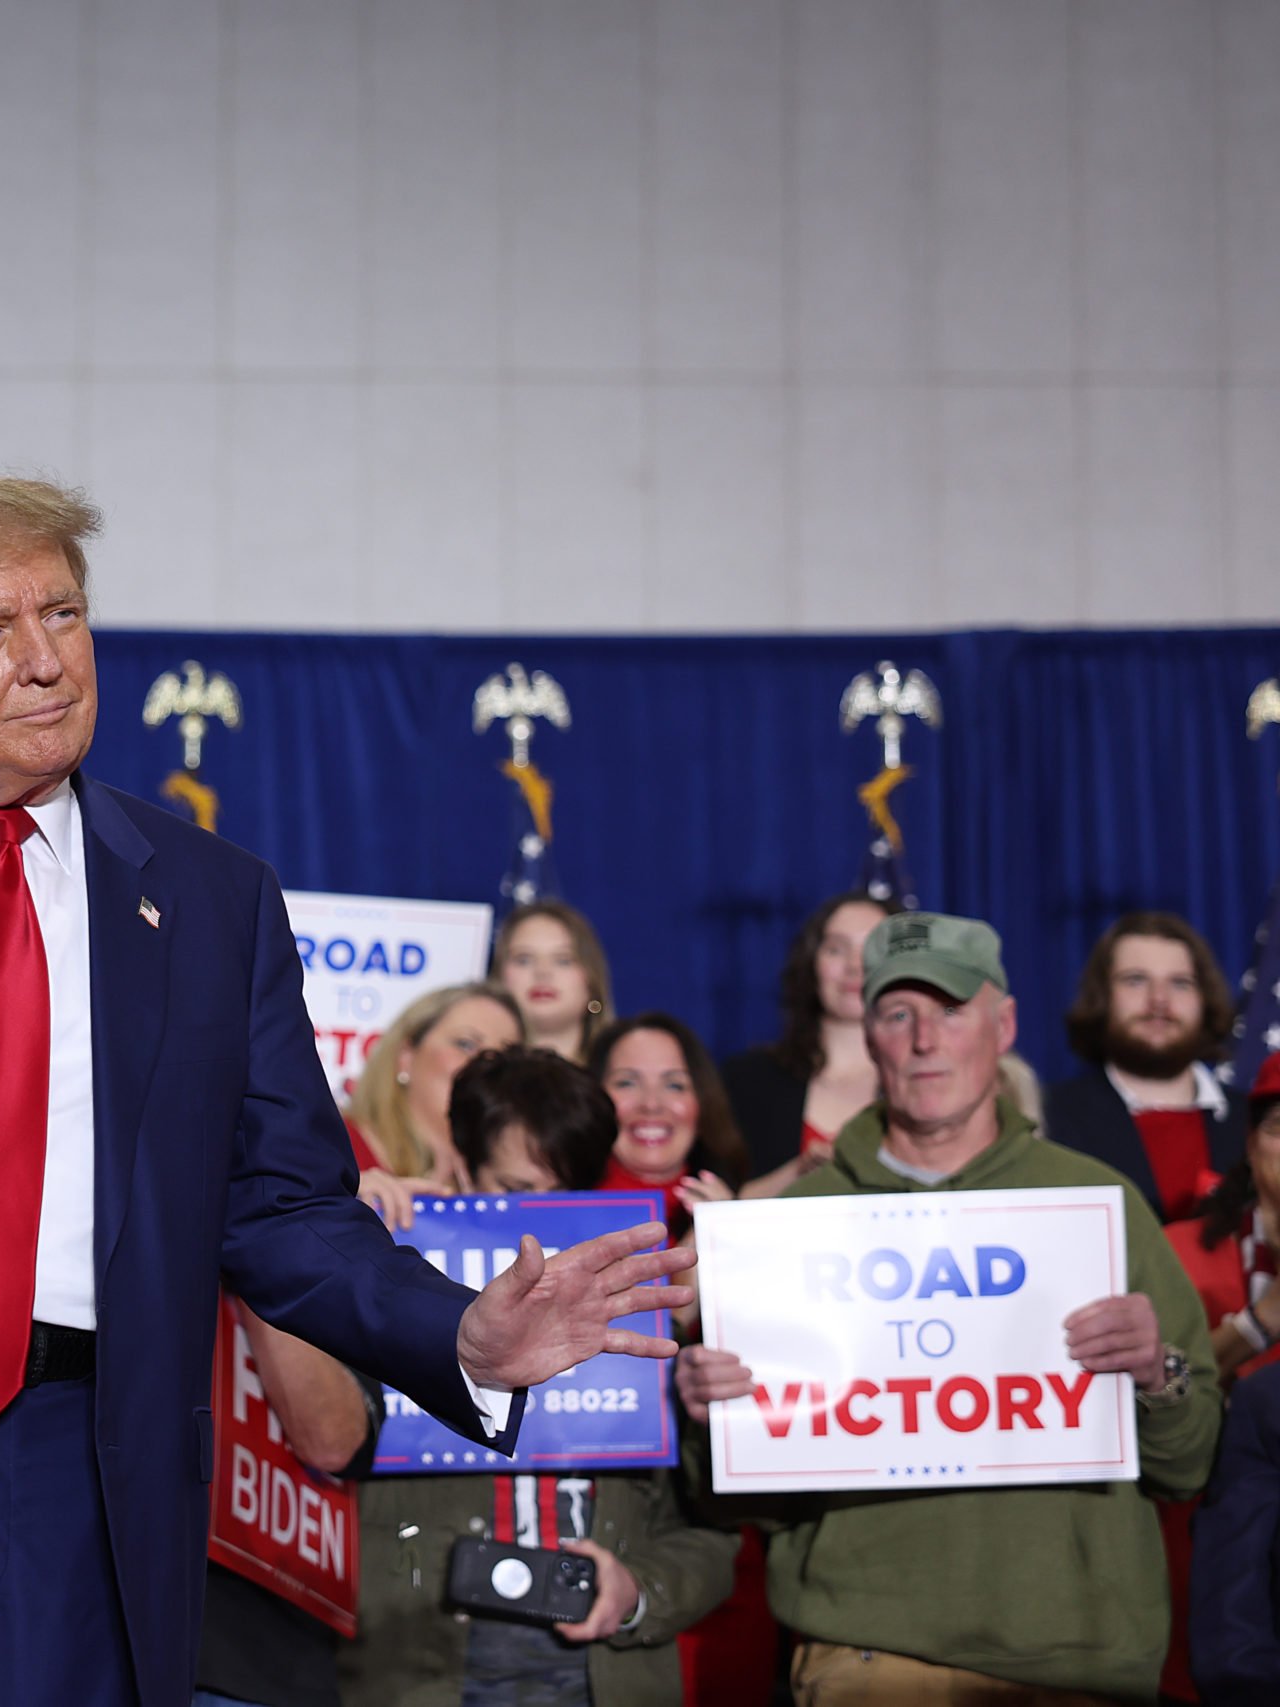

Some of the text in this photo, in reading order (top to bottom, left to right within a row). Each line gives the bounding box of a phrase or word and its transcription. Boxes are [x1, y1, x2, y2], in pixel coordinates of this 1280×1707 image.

[296, 936, 426, 975] ROAD
[337, 985, 382, 1021] TO
[802, 1246, 1026, 1301] ROAD
[885, 1319, 955, 1359] TO
[544, 1388, 639, 1413] 88022
[751, 1371, 1096, 1438] VICTORY
[231, 1443, 345, 1581] BIDEN
